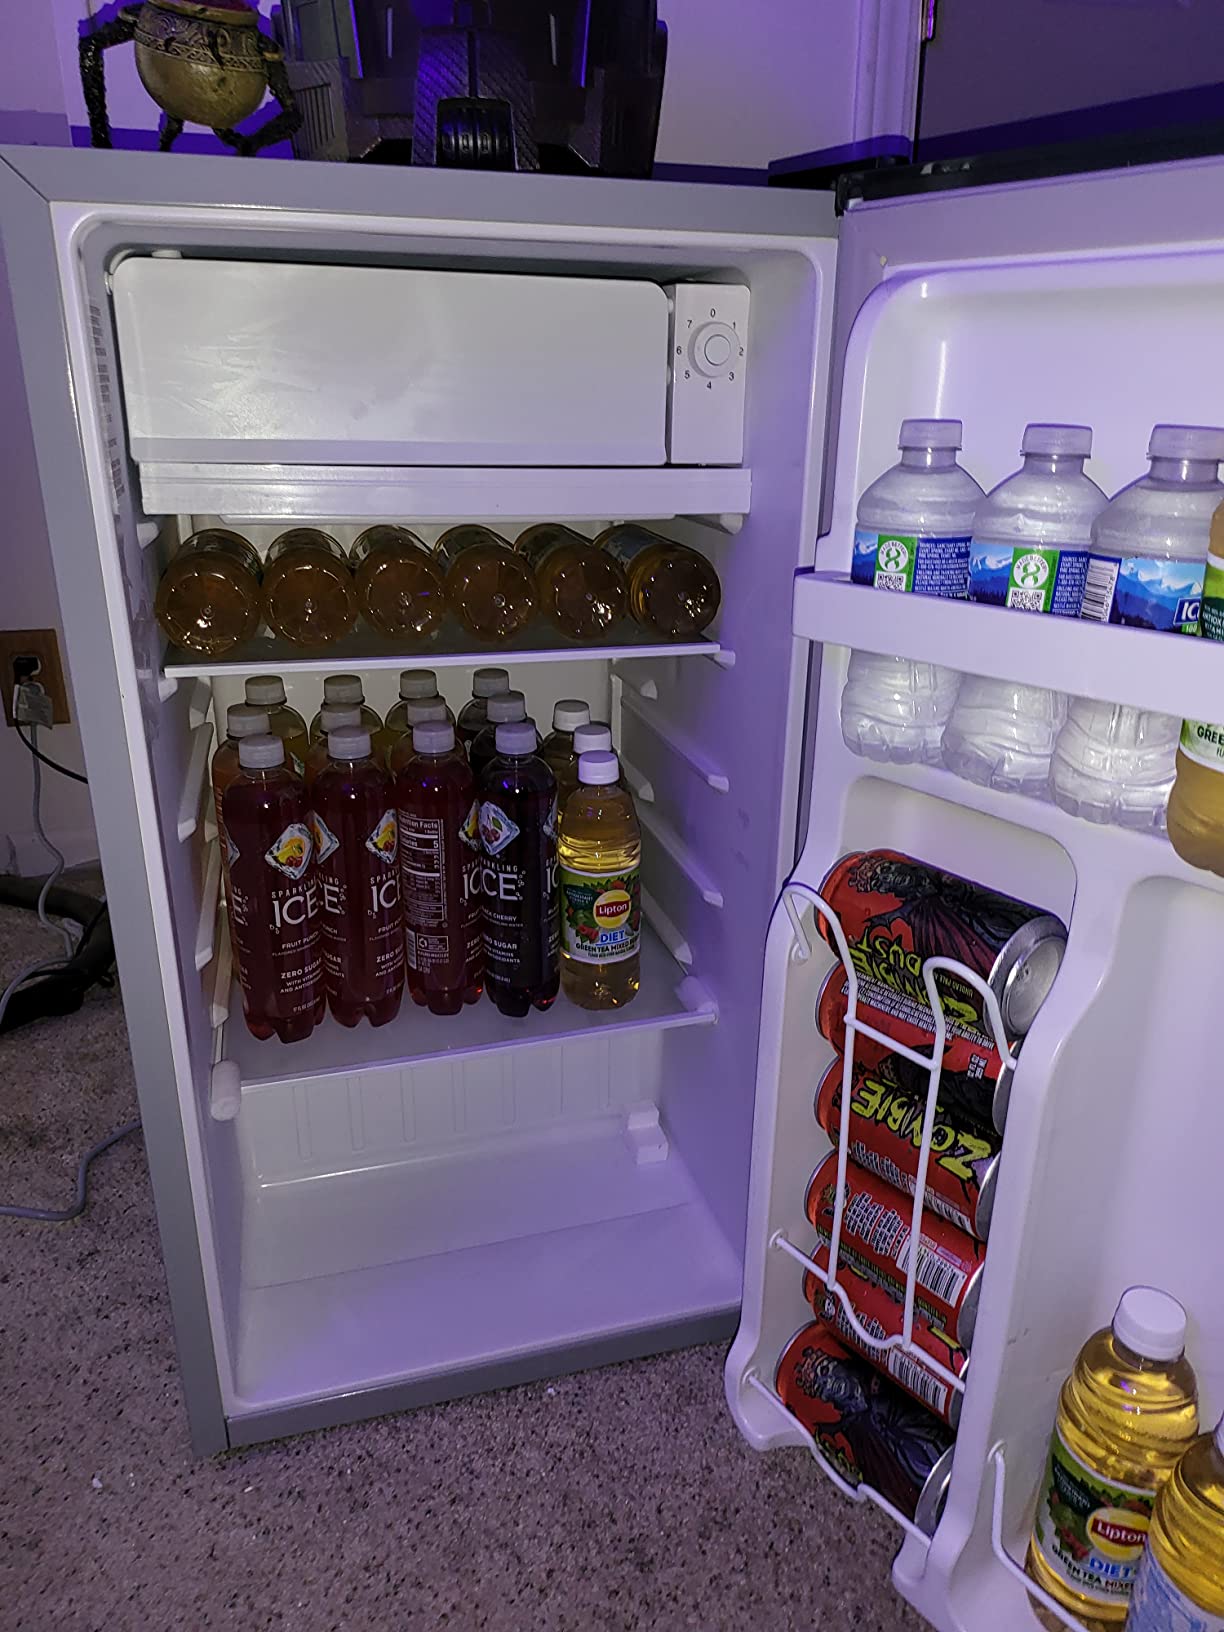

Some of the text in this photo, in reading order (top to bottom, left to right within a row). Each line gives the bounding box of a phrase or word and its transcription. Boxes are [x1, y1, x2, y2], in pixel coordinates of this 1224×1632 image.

[710, 308, 716, 318] 0
[687, 320, 692, 328] 7
[676, 346, 682, 355] 6
[739, 347, 744, 356] 2
[684, 370, 690, 379] 5
[729, 372, 734, 381] 3
[706, 381, 712, 389] 4
[433, 840, 439, 848] 5
[463, 867, 480, 900] IC
[272, 884, 318, 928] ICE
[600, 903, 627, 916] Lipton
[493, 912, 517, 922] CHERRY
[600, 930, 624, 943] DIET
[282, 940, 301, 950] FRUIT
[494, 940, 518, 950] SUGAR
[576, 942, 597, 952] GREEN
[376, 952, 394, 963] ZERO
[857, 929, 922, 977] DUST
[281, 968, 302, 979] ZERO
[851, 1080, 991, 1180] ZOMBIE
[1098, 1521, 1146, 1542] Lipton
[1089, 1558, 1132, 1578] DIET
